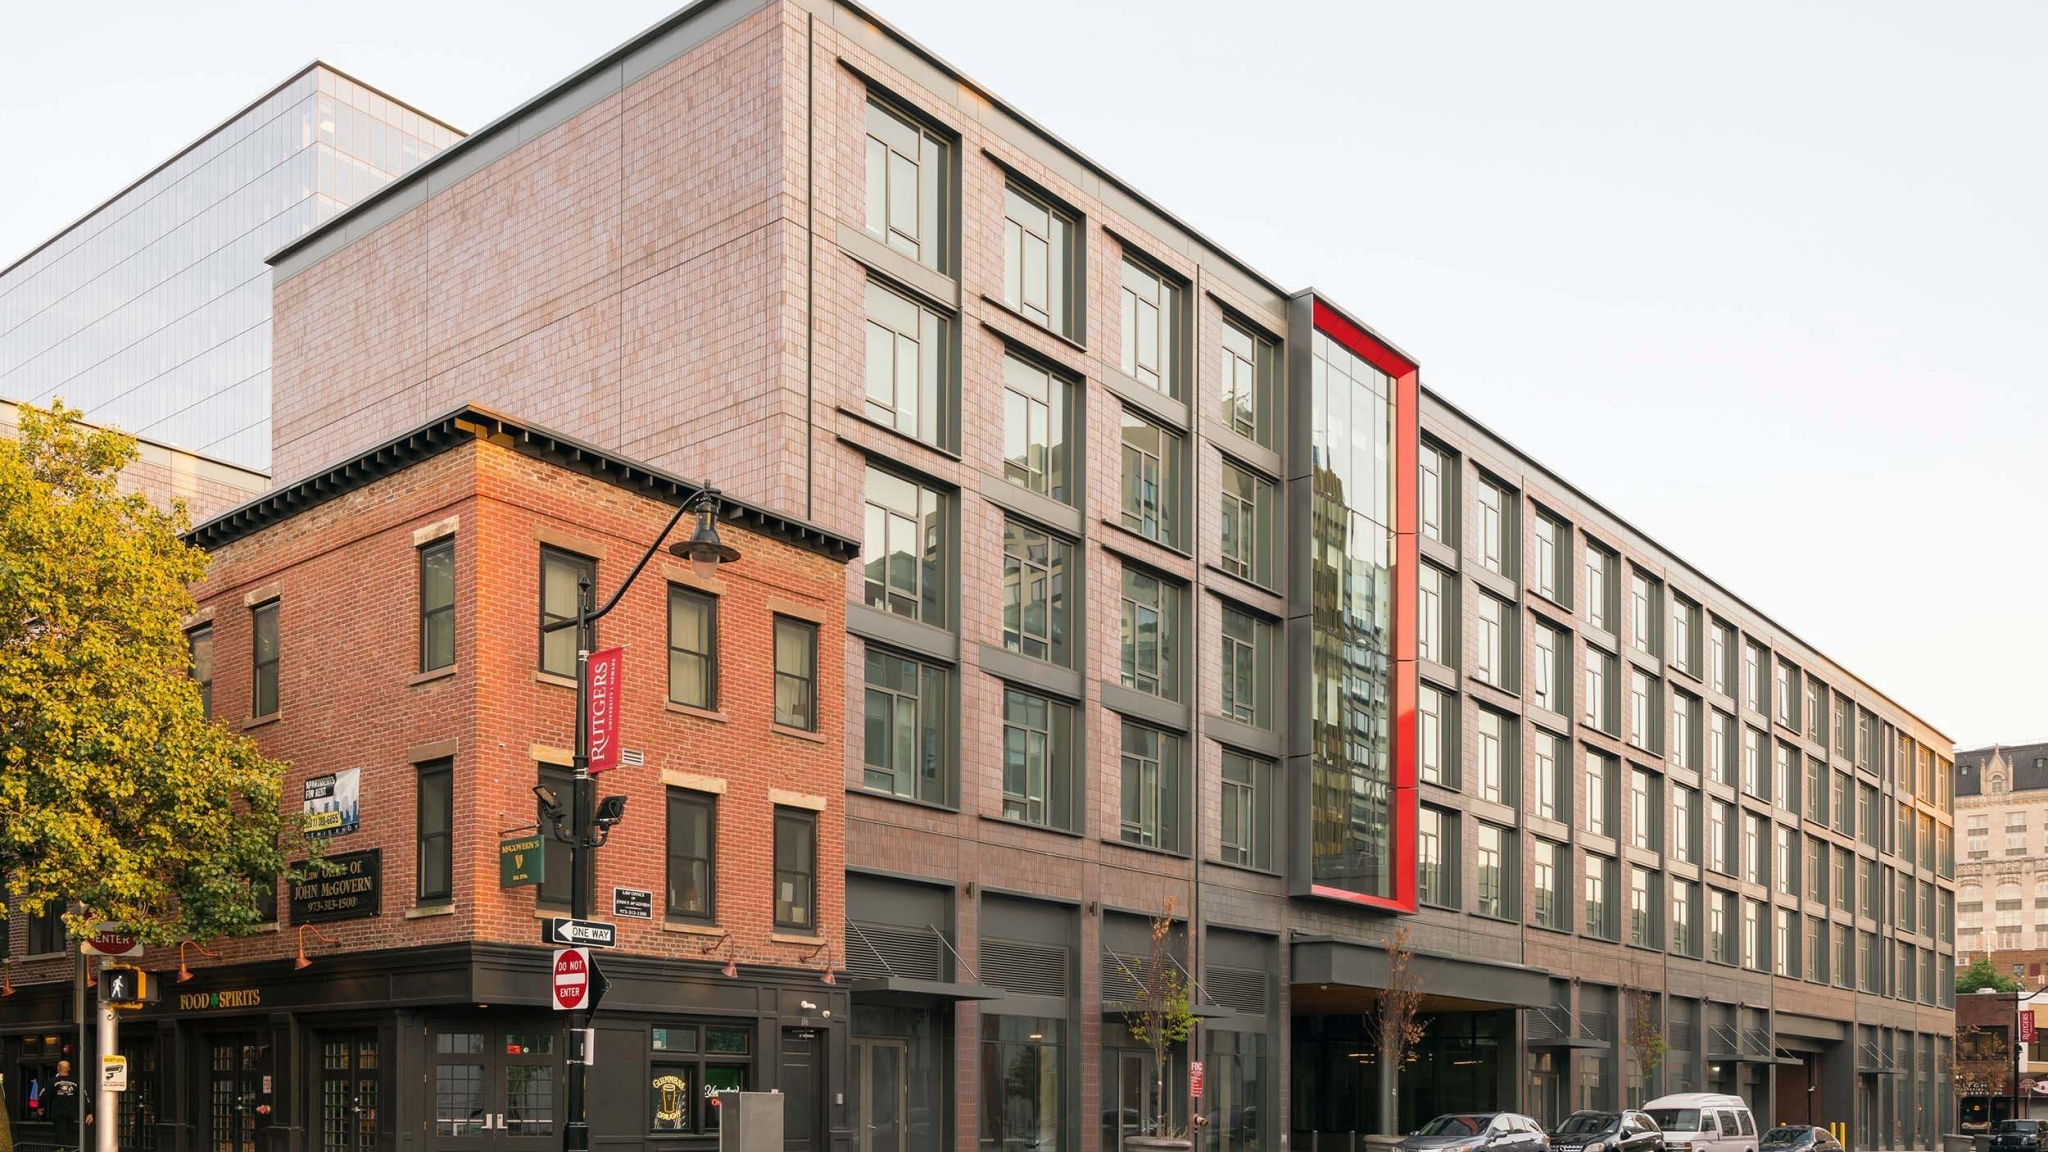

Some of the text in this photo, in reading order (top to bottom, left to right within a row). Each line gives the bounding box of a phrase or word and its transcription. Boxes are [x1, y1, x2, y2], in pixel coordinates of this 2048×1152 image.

[591, 661, 610, 762] RUTGERS
[305, 776, 336, 790] APARTMENTS
[305, 787, 327, 800] FOR RENT
[350, 860, 363, 874] Of
[294, 876, 373, 900] JOHN McGOVERN
[308, 896, 357, 912] 973-313-1500
[96, 934, 130, 945] ENTER
[572, 927, 610, 940] ONE WAY
[558, 961, 583, 972] DO NOT
[180, 989, 260, 1010] FOOD SPIRITS
[560, 987, 580, 998] ENTER
[2022, 1013, 2031, 1040] RUTGERS
